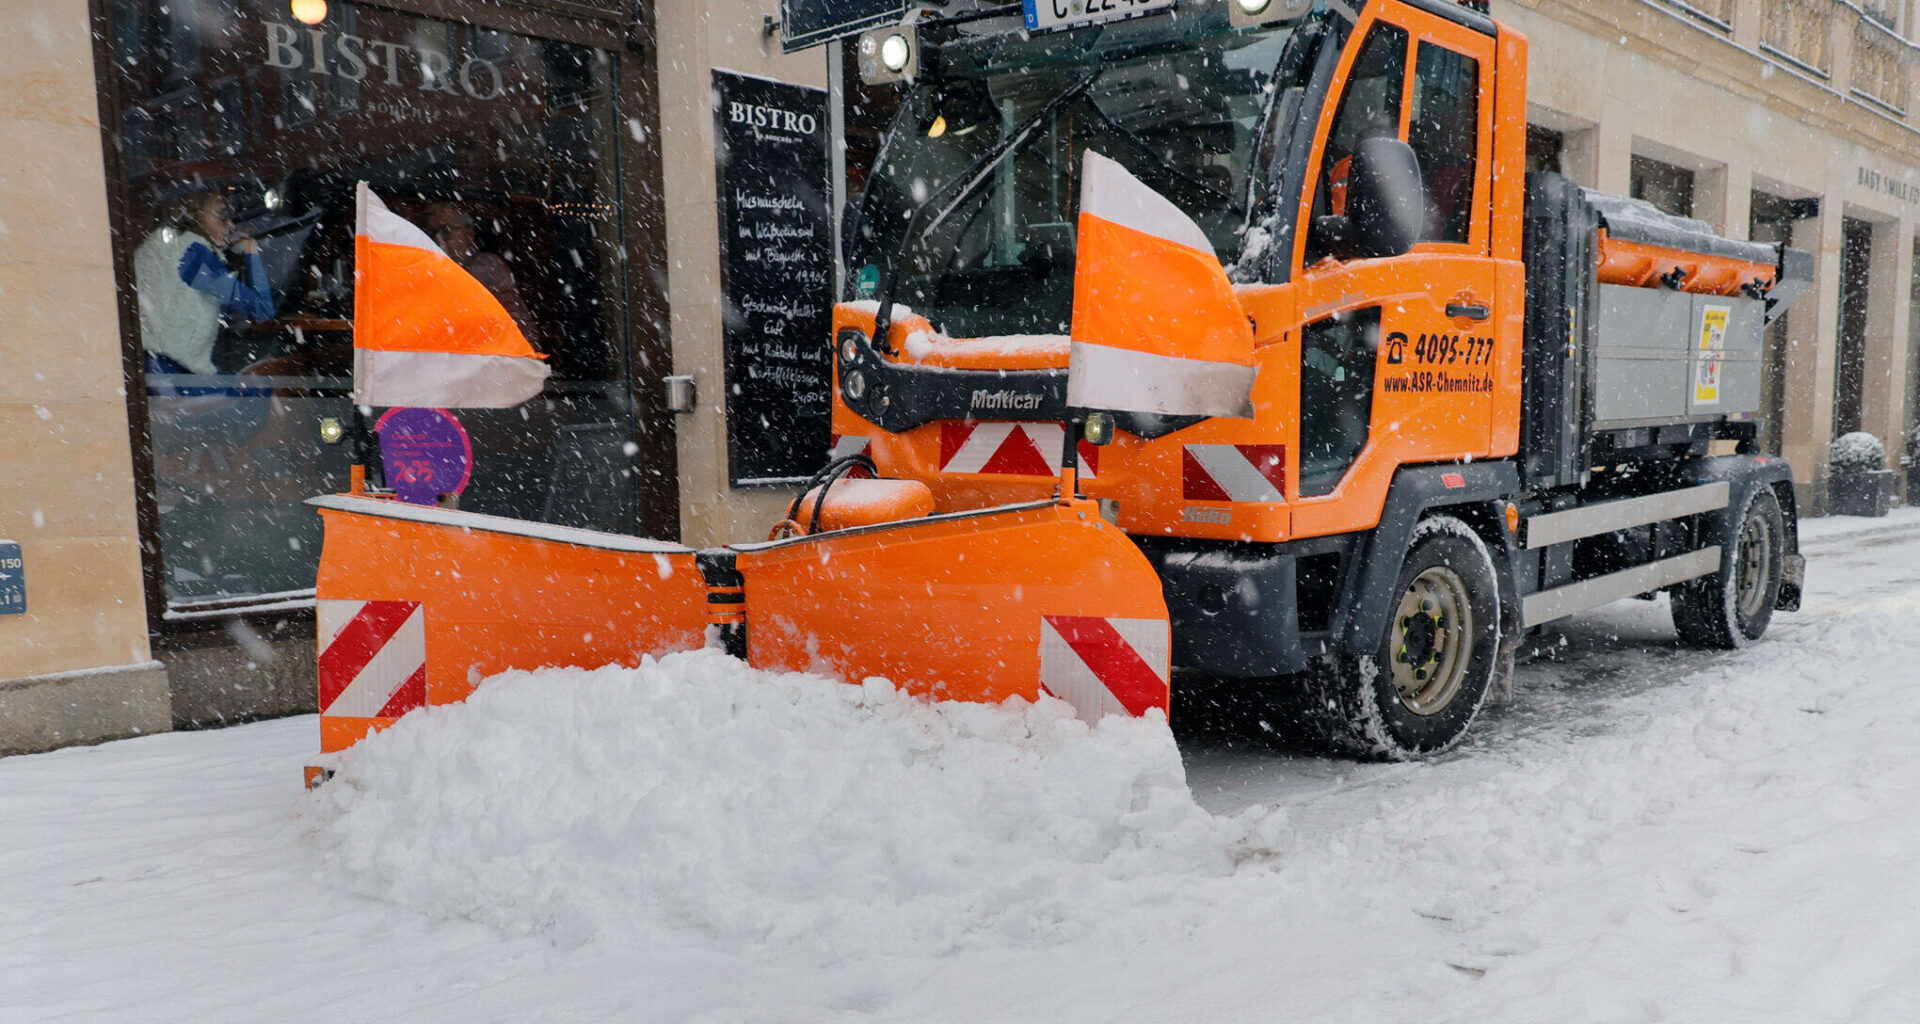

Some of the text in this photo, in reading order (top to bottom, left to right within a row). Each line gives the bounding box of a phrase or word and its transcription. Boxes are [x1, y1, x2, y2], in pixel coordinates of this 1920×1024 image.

[259, 19, 506, 100] BISTRO
[730, 101, 816, 134] BISTRO
[1858, 166, 1880, 191] BABY
[1883, 176, 1907, 200] SMILE
[1415, 333, 1494, 365] 4095-777
[1384, 371, 1493, 393] www.ASR-Chemnitz.de
[971, 389, 1043, 409] Multicar
[1183, 505, 1232, 525] Hako
